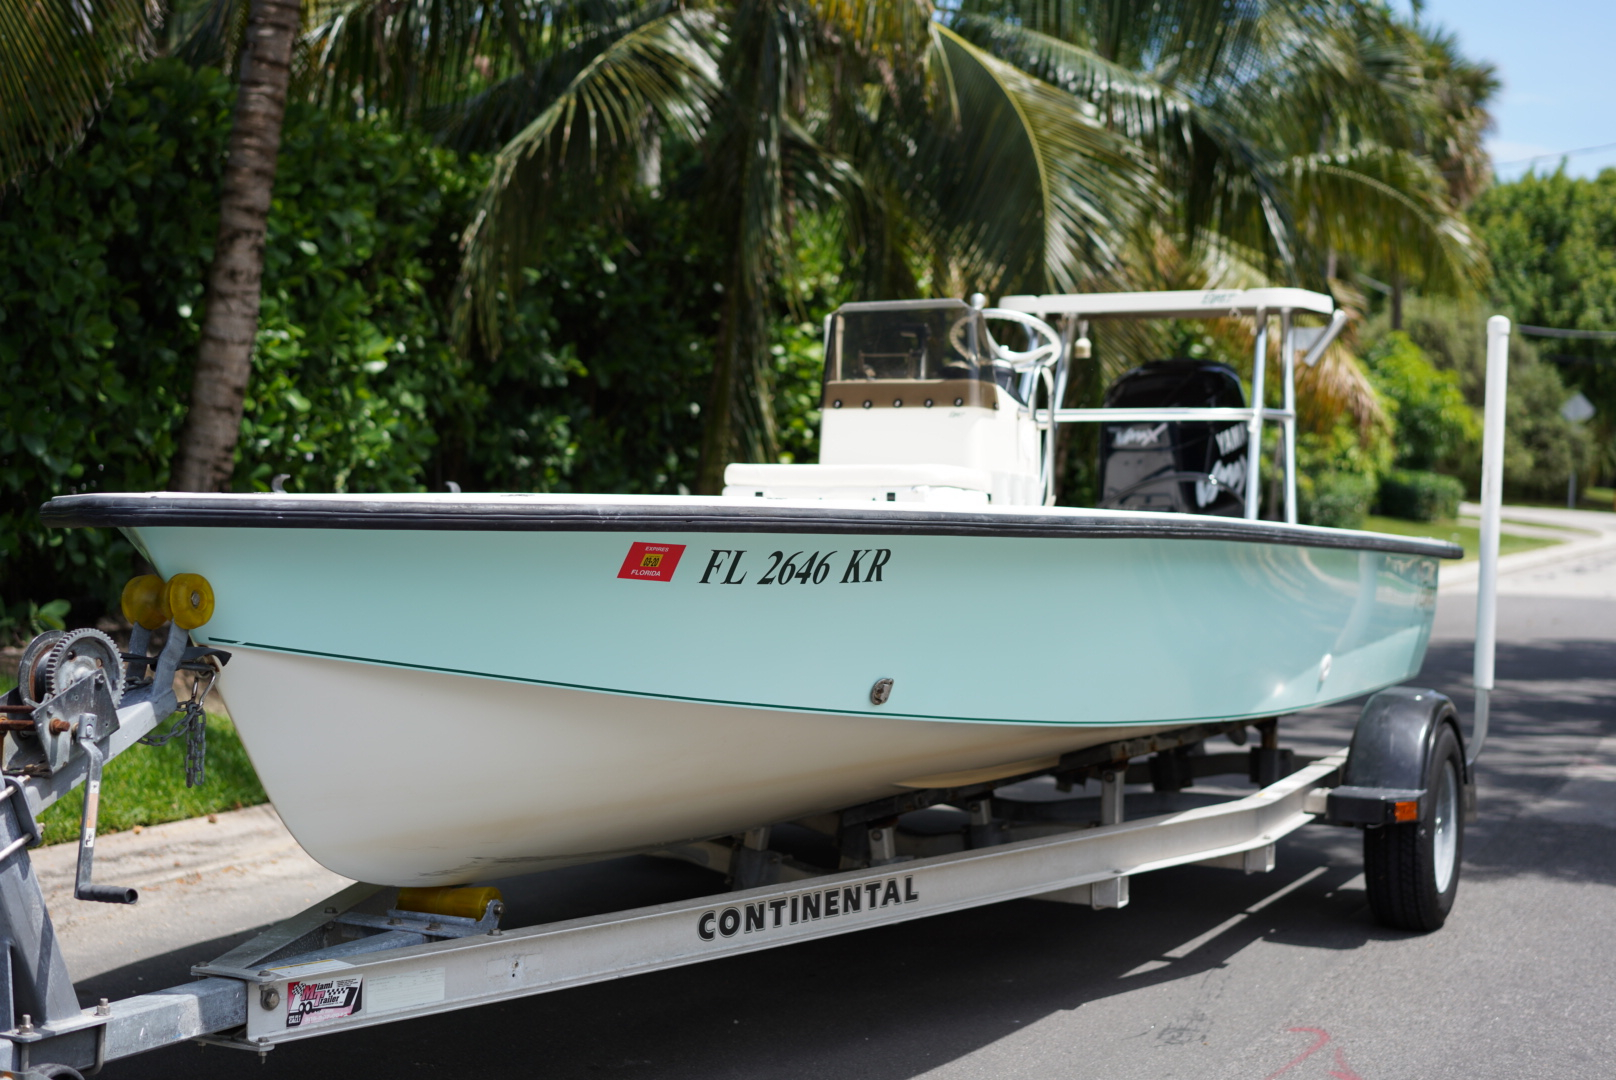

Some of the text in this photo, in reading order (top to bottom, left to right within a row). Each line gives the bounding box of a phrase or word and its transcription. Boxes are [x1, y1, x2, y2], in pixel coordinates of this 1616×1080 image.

[631, 569, 660, 577] FLORIDA
[697, 549, 891, 585] FL 2646 KR
[697, 875, 919, 941] CONTINENTAL
[301, 981, 334, 1001] Miami
[311, 990, 340, 1007] Trailer
